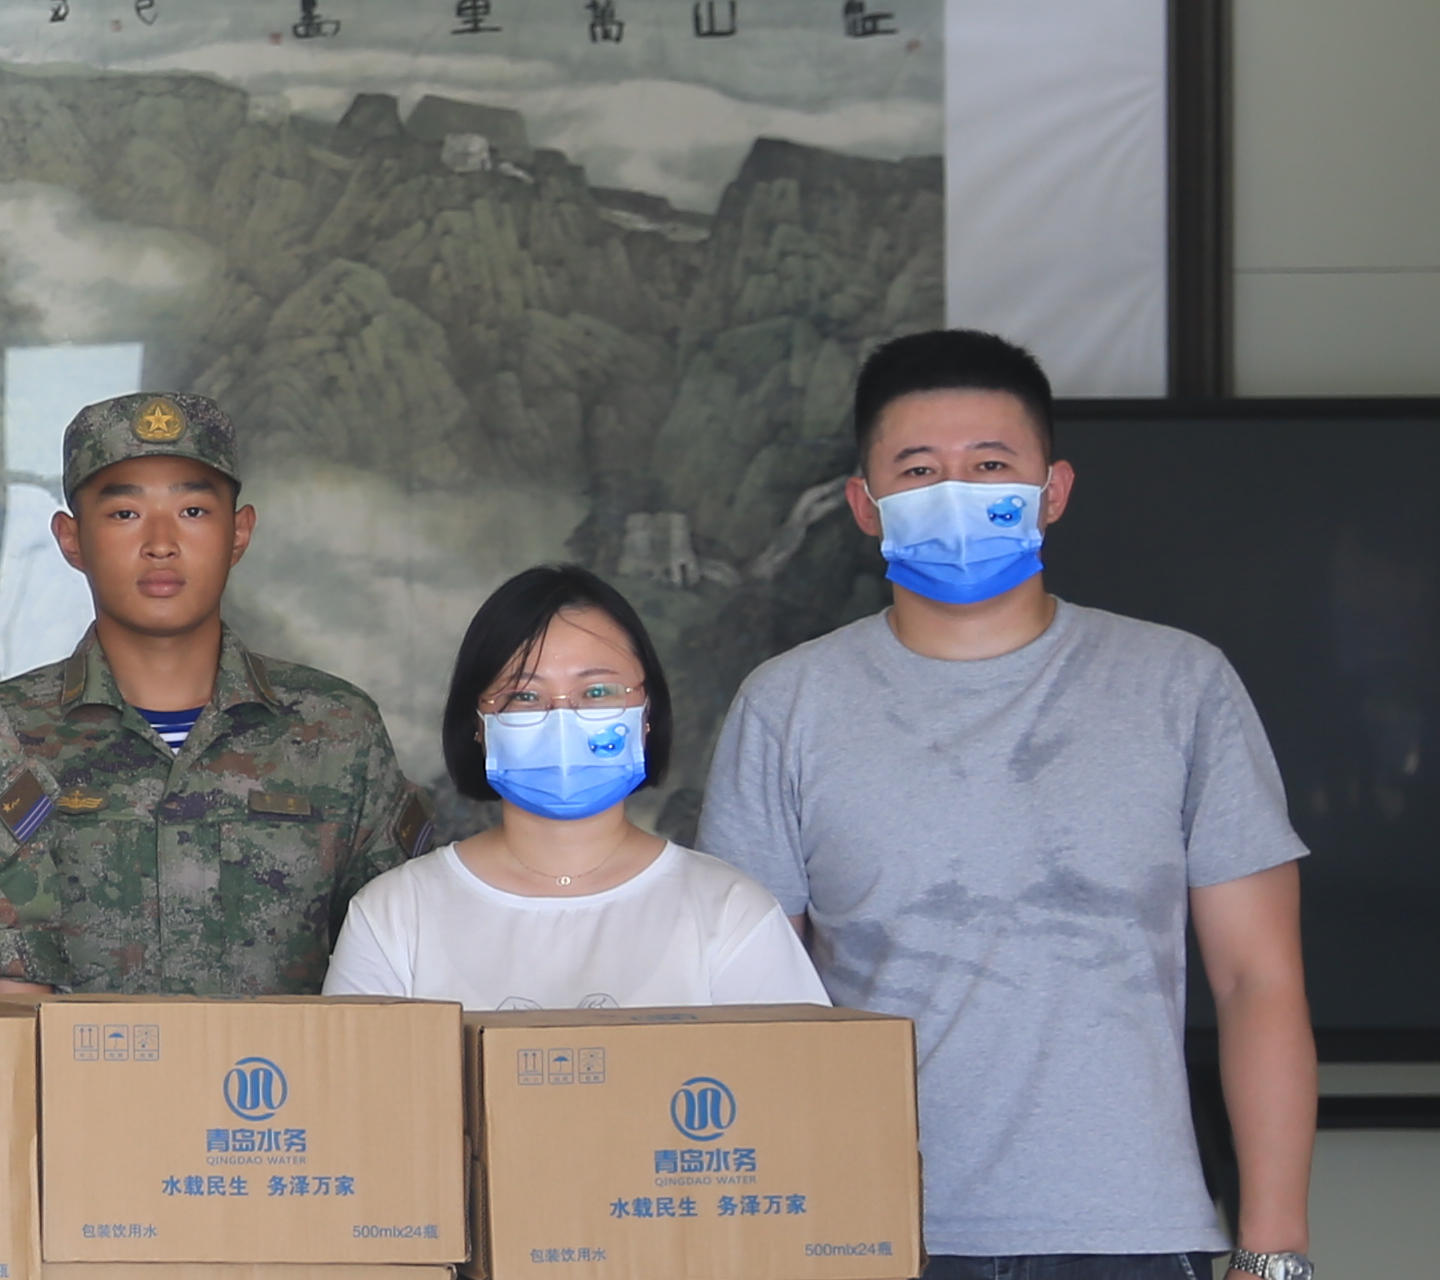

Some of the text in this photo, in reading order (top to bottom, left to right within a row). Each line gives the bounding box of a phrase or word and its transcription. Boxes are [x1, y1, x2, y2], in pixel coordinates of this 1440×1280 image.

[207, 1128, 308, 1153] 青岛水务
[654, 1148, 757, 1174] 青岛水务
[162, 1175, 356, 1197] 水载民生 务泽万家
[654, 1175, 758, 1188] QINGDAO WATER
[610, 1193, 807, 1219] 水载民生 务泽万家
[81, 1223, 158, 1239] 包装饮用水
